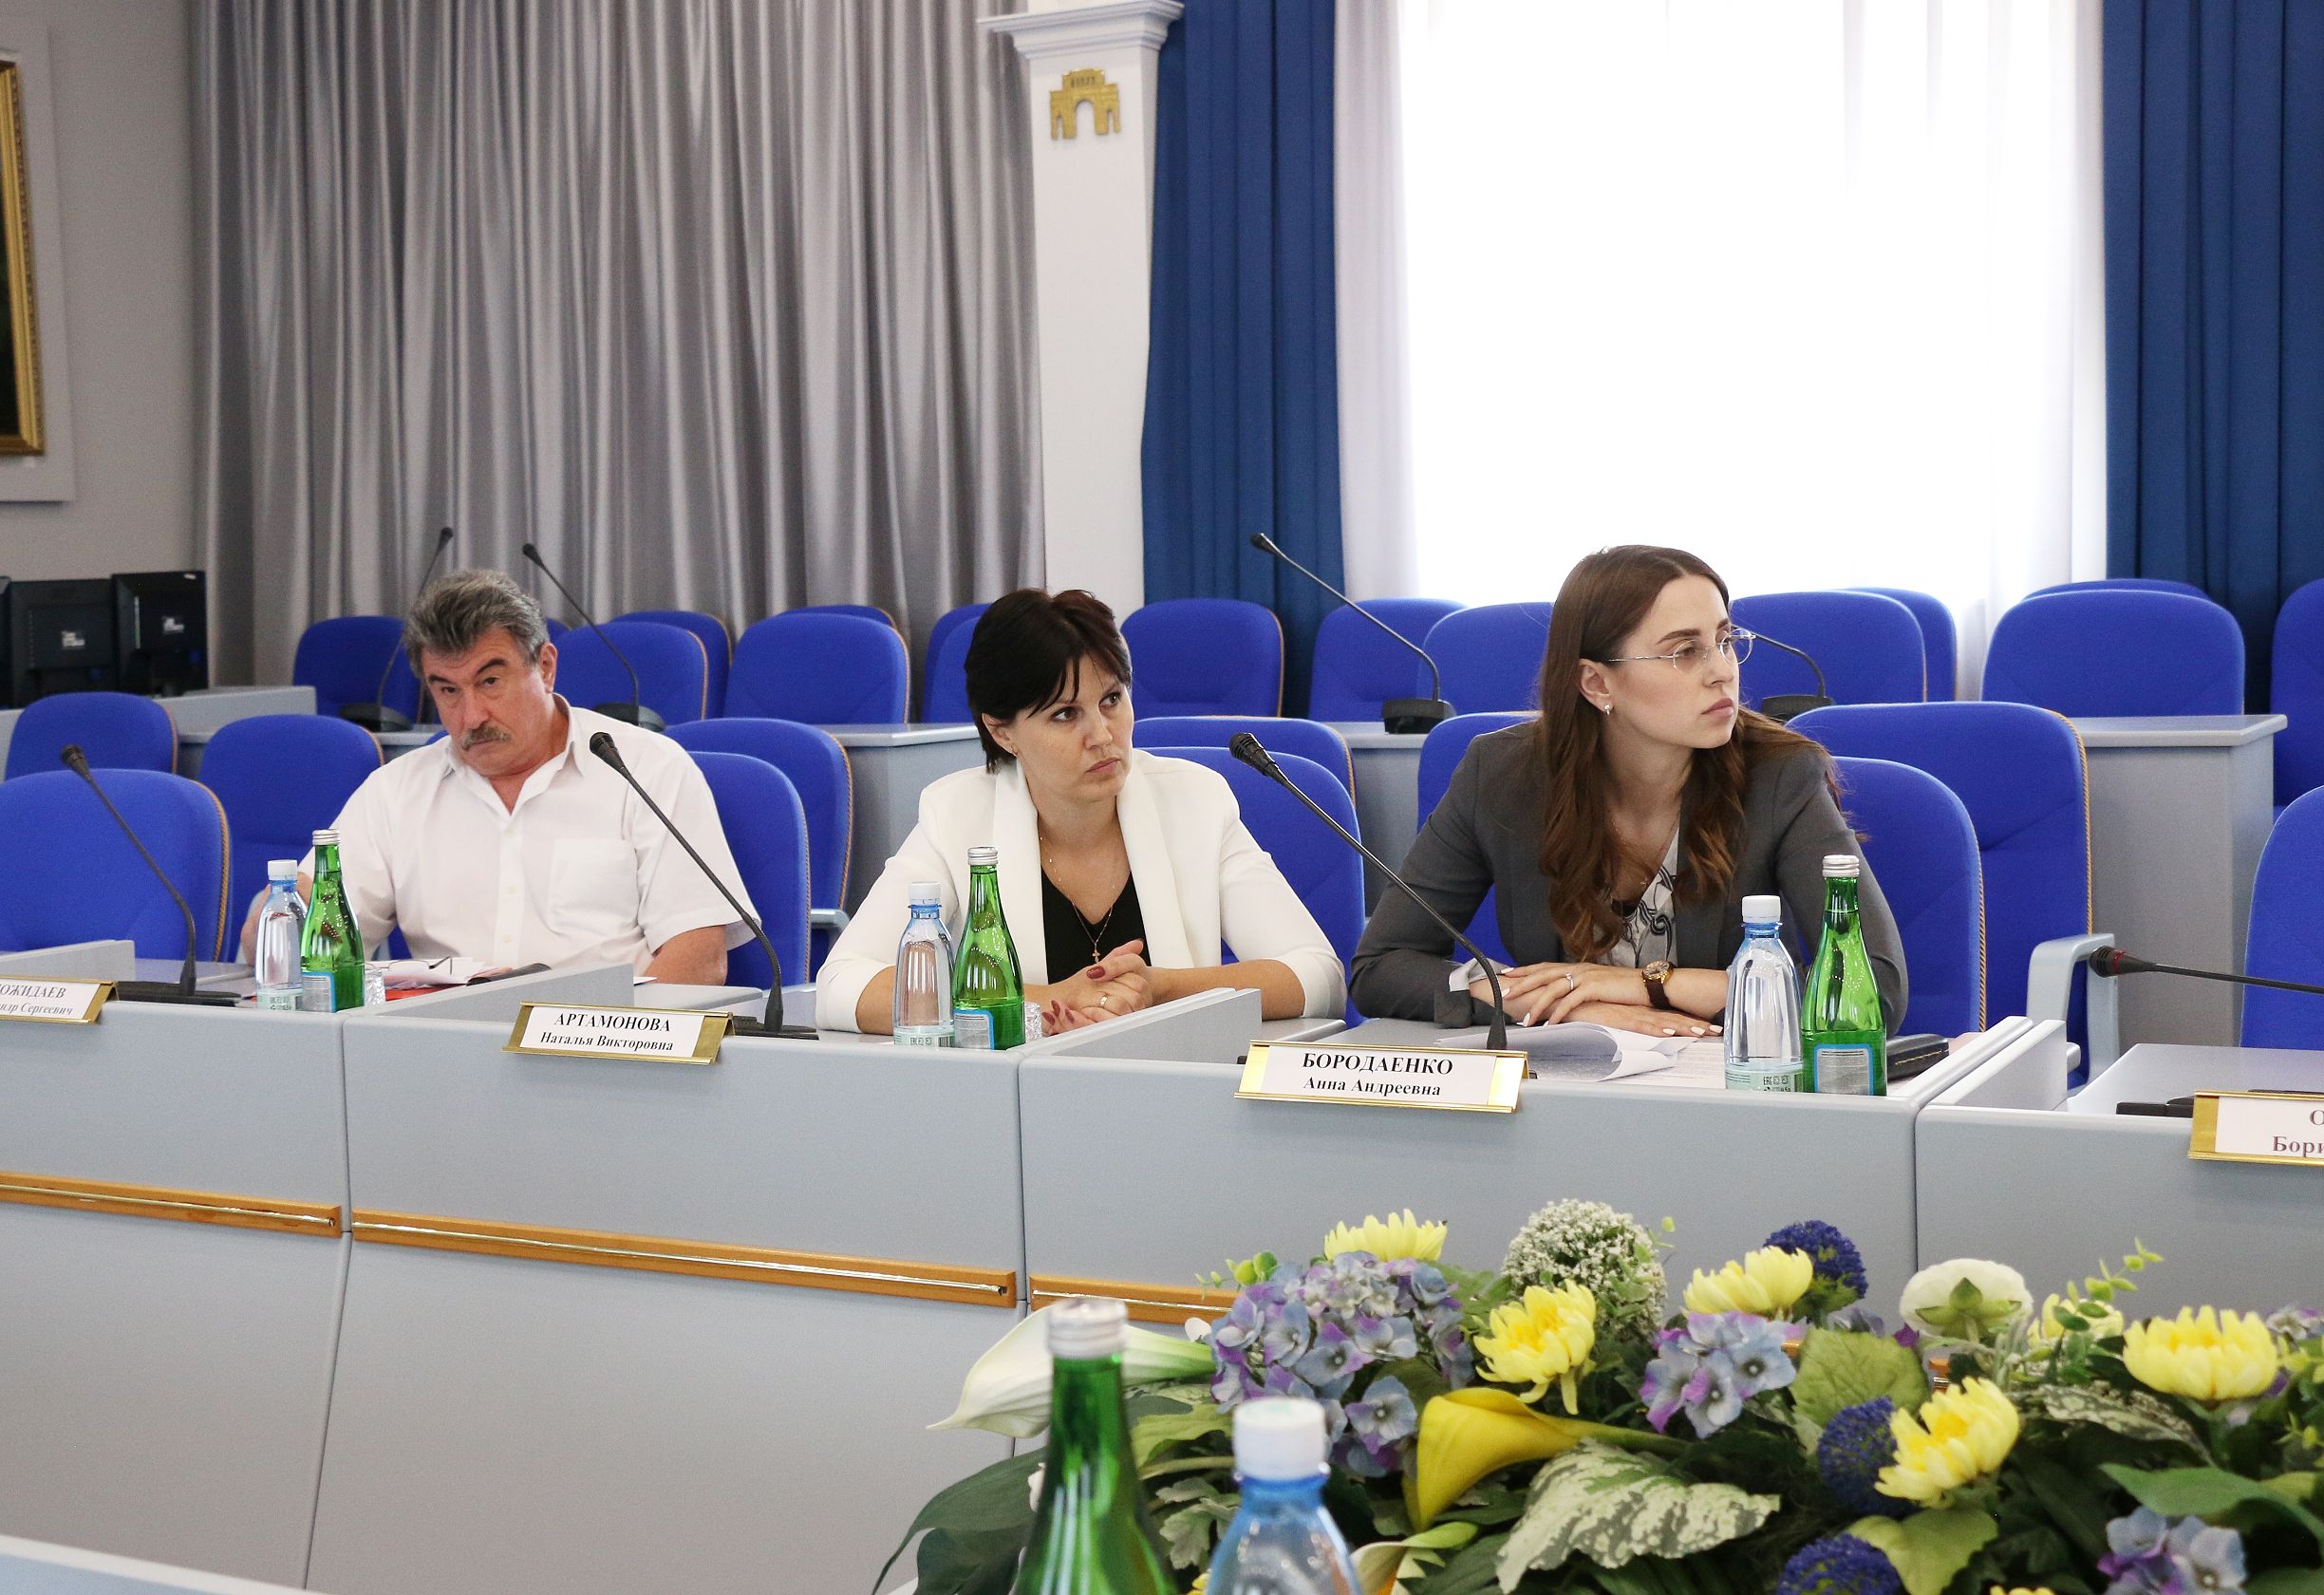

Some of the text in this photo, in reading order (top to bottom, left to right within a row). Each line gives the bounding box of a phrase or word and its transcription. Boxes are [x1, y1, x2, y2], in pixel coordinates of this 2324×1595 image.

[0, 985, 66, 999] ОЖИДАЕВ
[21, 1003, 73, 1015] Сергеевич
[554, 1013, 670, 1032] АРТАМОНОВА
[540, 1032, 673, 1051] Наталья Викторовна
[1303, 1053, 1453, 1075] БОРОДАЕНКО
[1304, 1077, 1441, 1097] Анна Андреевна
